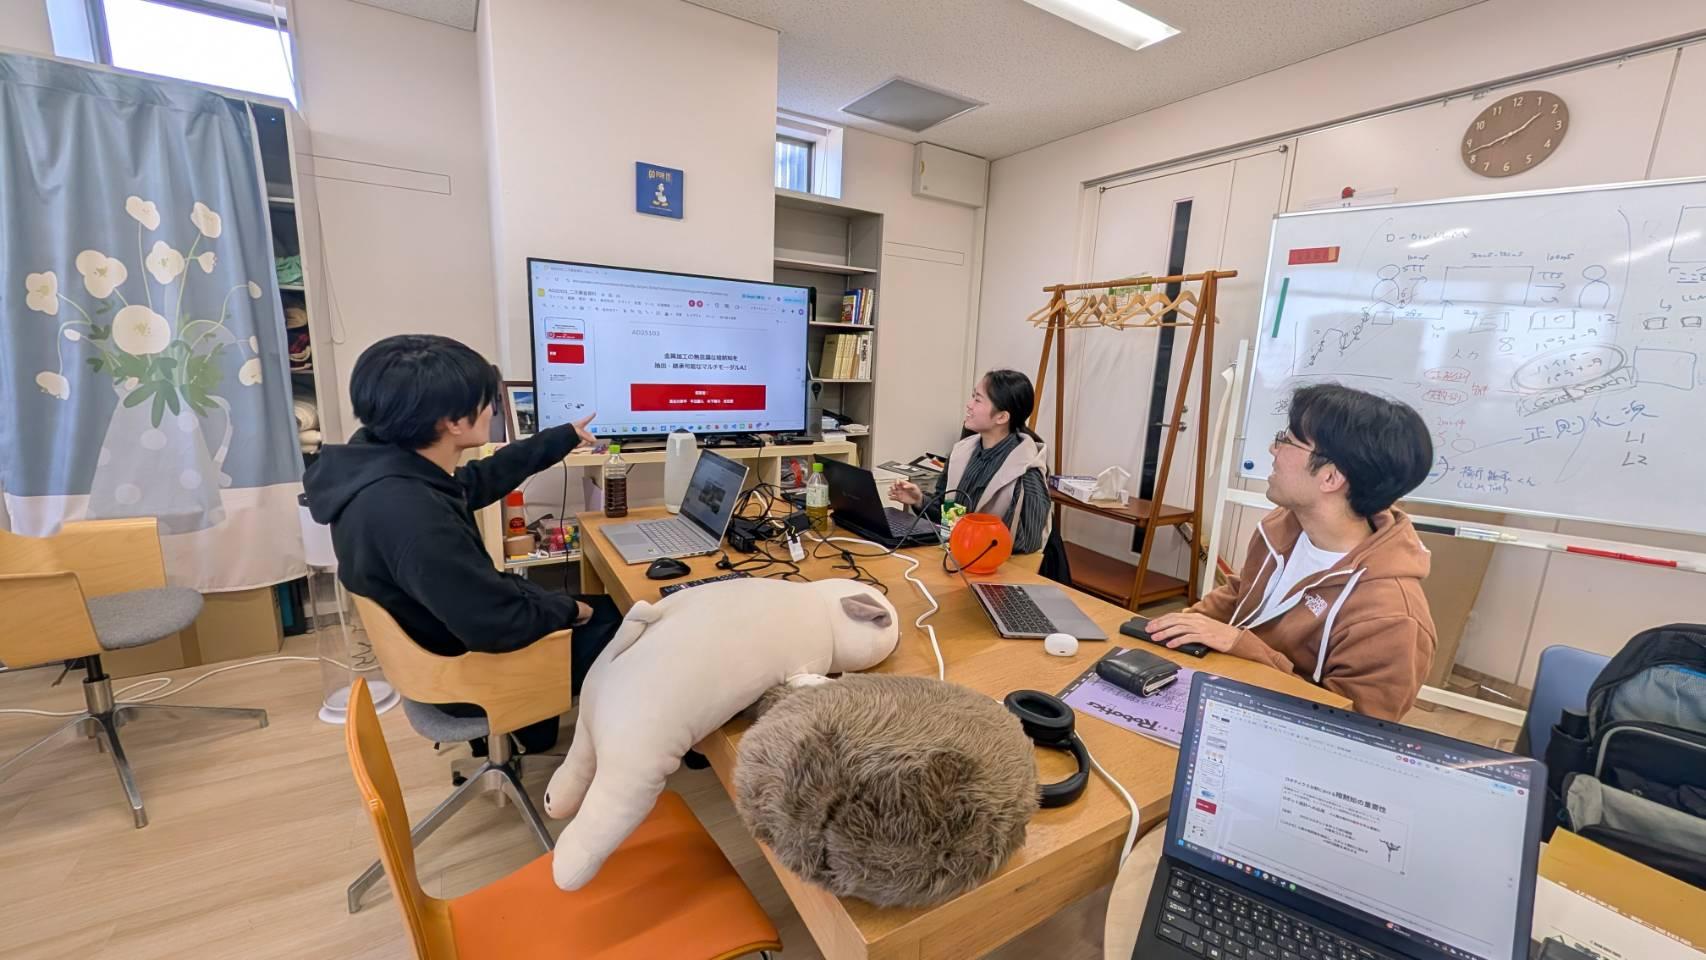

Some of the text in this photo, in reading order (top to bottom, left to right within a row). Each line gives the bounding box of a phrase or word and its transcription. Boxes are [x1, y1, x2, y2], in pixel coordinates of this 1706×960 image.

[1513, 96, 1524, 107] 12
[1537, 96, 1542, 105] 1
[1493, 106, 1502, 116] 11
[1551, 104, 1558, 114] 2
[1476, 120, 1485, 130] 10
[1554, 120, 1562, 130] 3
[1466, 139, 1472, 148] 9
[1543, 139, 1551, 148] 4
[1470, 154, 1476, 164] 8
[1526, 154, 1532, 164] 5
[1483, 162, 1490, 171] 7
[1503, 162, 1510, 171] 6
[1086, 701, 1159, 731] Robotics
